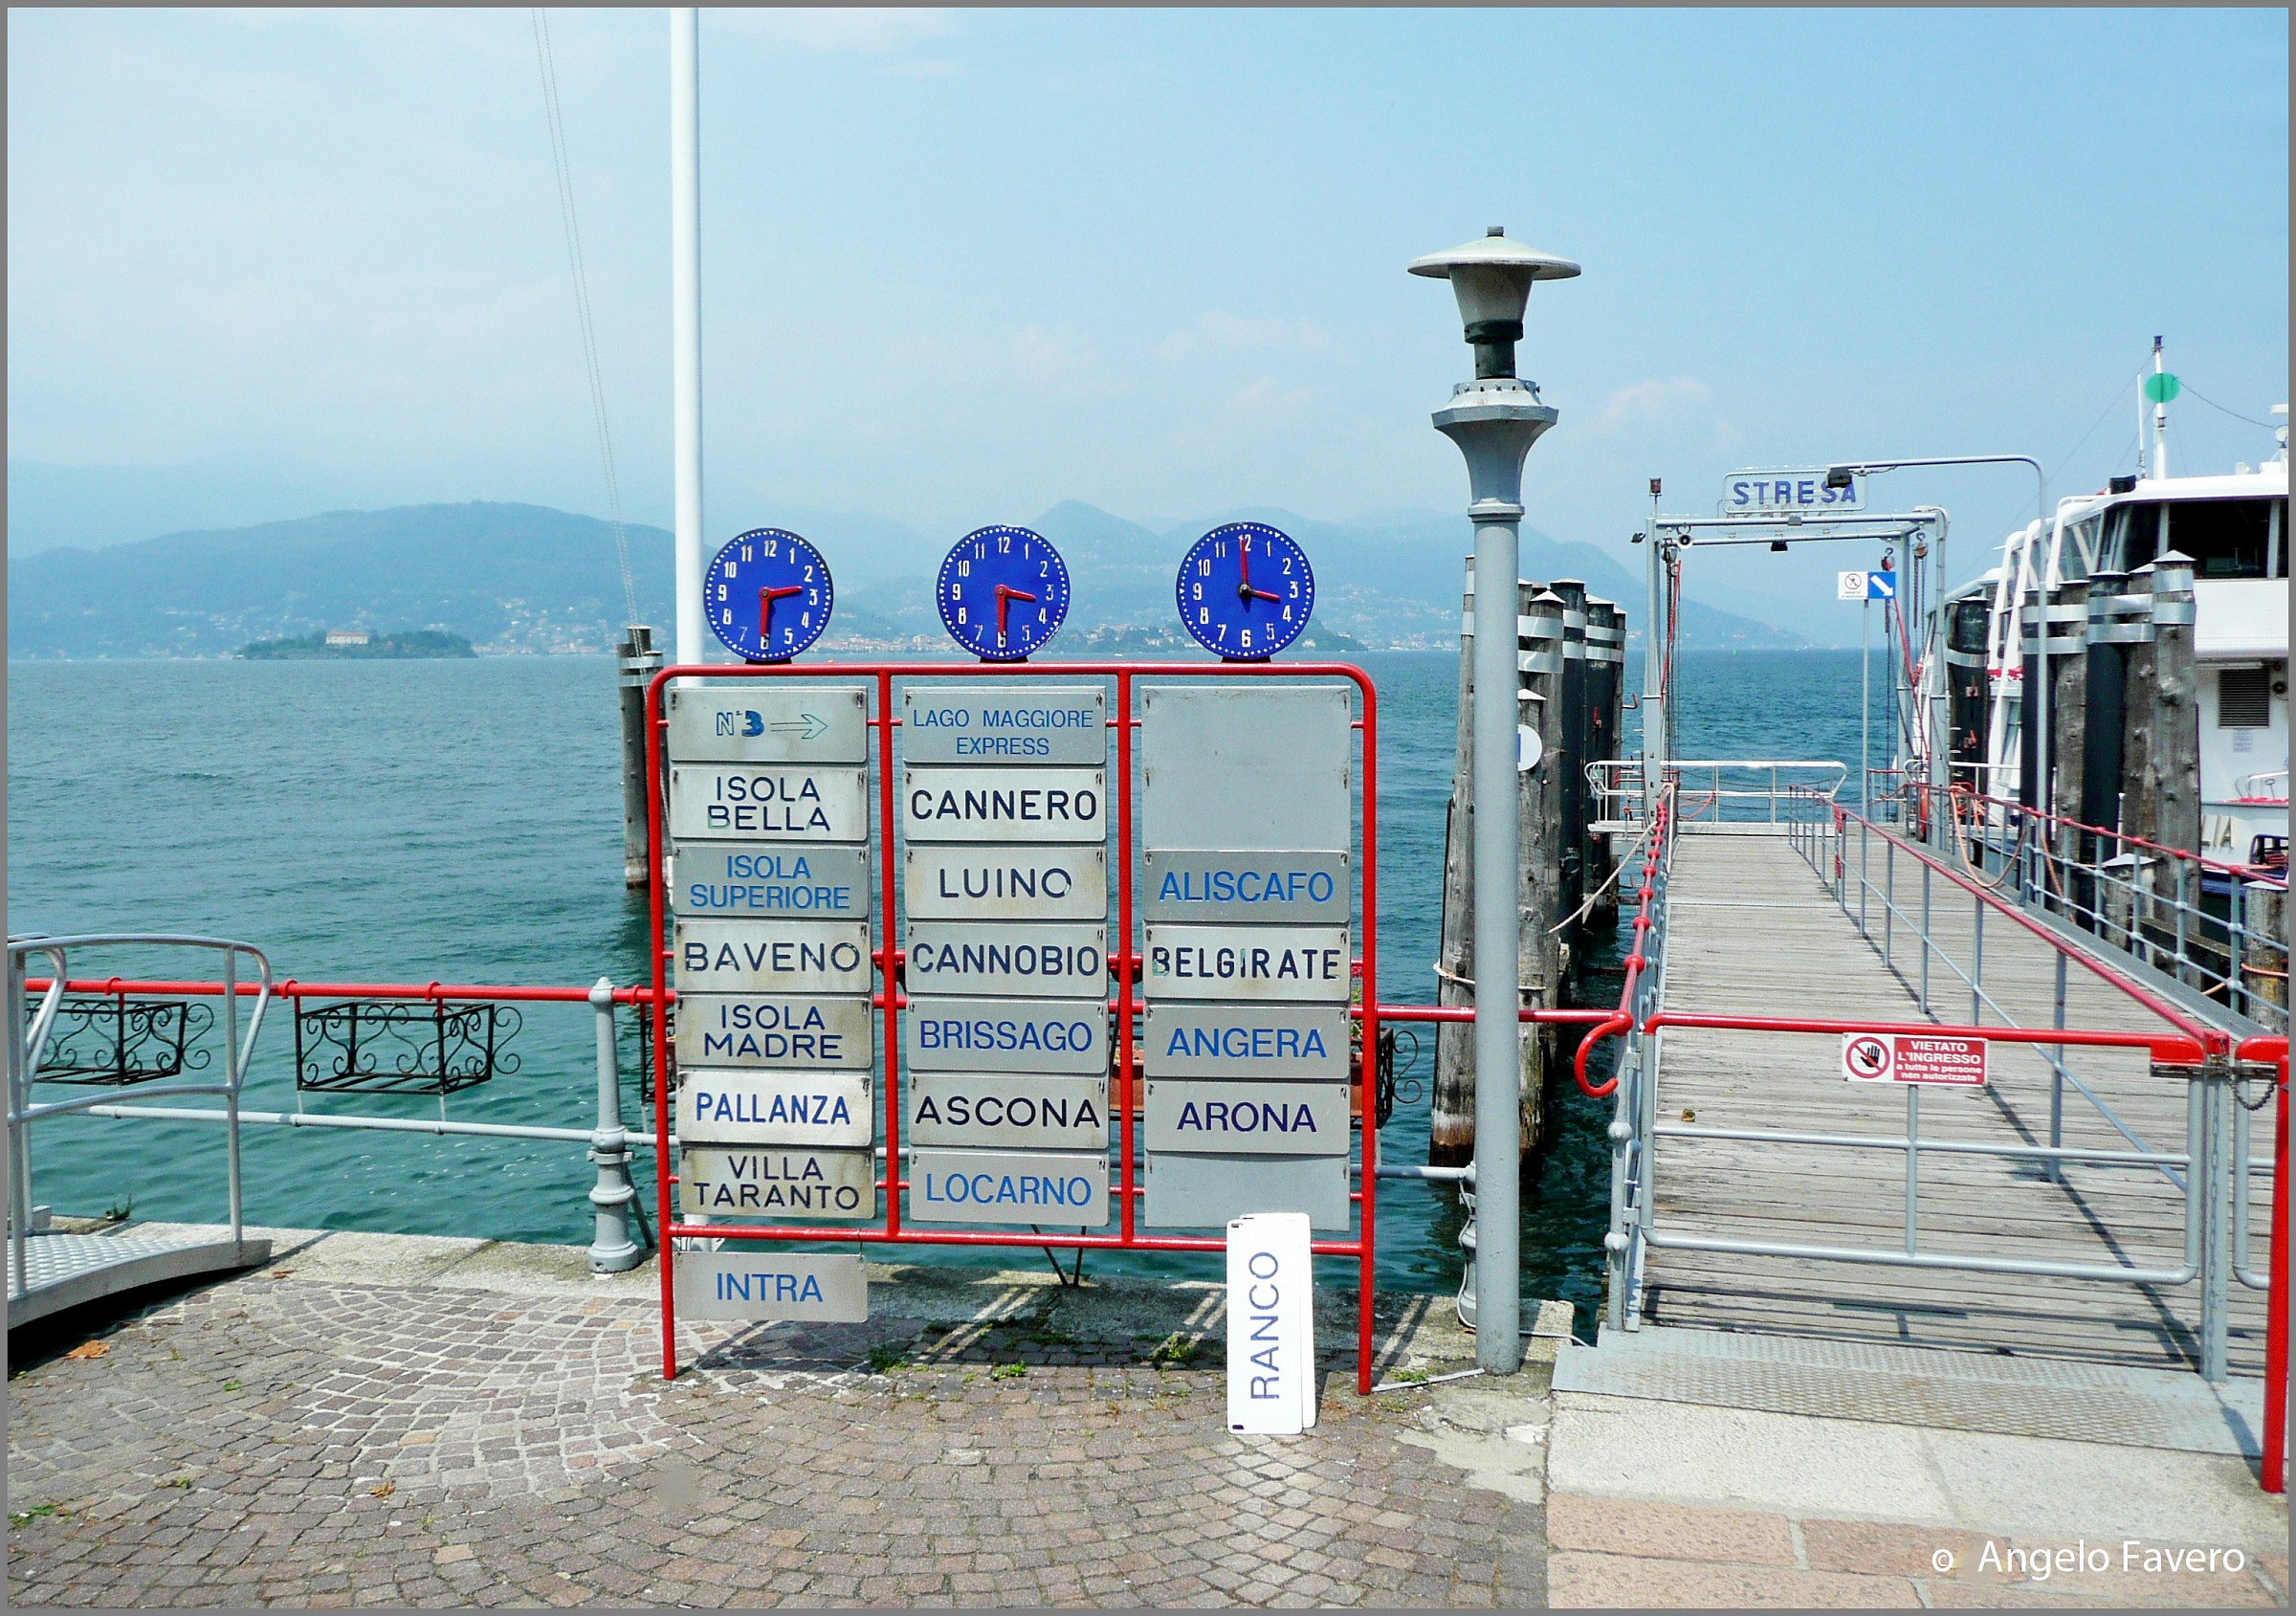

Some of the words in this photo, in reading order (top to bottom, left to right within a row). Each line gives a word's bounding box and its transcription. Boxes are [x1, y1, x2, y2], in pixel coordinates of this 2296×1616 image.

[1733, 480, 1856, 505] STRESA
[741, 545, 753, 562] 11
[764, 540, 777, 557] 12
[975, 542, 984, 559] 11
[998, 537, 1010, 553] 12
[1024, 542, 1029, 560] 1
[1215, 542, 1225, 558] 11
[1266, 541, 1271, 557] 1
[789, 547, 795, 564] 1
[724, 562, 737, 578] 10
[804, 565, 813, 583] 2
[958, 560, 970, 577] 10
[1040, 561, 1048, 577] 2
[1198, 559, 1210, 576] 10
[1283, 557, 1292, 575] 2
[718, 585, 727, 601] 9
[809, 588, 818, 606] 3
[952, 584, 960, 601] 9
[1046, 584, 1053, 601] 3
[1193, 583, 1202, 600] 9
[1290, 581, 1298, 598] 3
[722, 609, 732, 625] 8
[801, 611, 809, 629] 4
[958, 608, 966, 624] 8
[1038, 608, 1048, 624] 4
[1200, 607, 1209, 624] 8
[1283, 605, 1292, 623] 4
[739, 626, 748, 642] 7
[784, 628, 793, 645] 5
[974, 625, 983, 641] 7
[1022, 625, 1030, 641] 5
[1217, 624, 1226, 642] 7
[1242, 630, 1251, 648] 6
[1266, 623, 1274, 640] 5
[913, 709, 970, 727] LAGO
[982, 710, 1093, 728] MAGGIORE
[957, 737, 1049, 756] EXPRESS
[717, 776, 821, 802] ISOLA
[911, 789, 1097, 821] CANNERO
[707, 805, 830, 831] BELLA
[727, 855, 811, 879] ISOLA
[939, 868, 1072, 898] LUINO
[1159, 871, 1334, 903] ALISCAFO
[690, 884, 850, 909] SUPERIORE
[684, 941, 861, 973] BAVENO
[912, 942, 1099, 976] CANNOBIO
[1152, 946, 1340, 981] BELGIRATE
[721, 1004, 826, 1030] ISOLA
[920, 1020, 1093, 1052] BRISSAGO
[1166, 1028, 1328, 1058] ANGERA
[704, 1032, 843, 1059] MADRE
[1910, 1040, 1968, 1052] VIETATO
[1897, 1052, 1981, 1065] L'INGRESSO
[1922, 1073, 1977, 1081] autorizzate
[696, 1092, 850, 1125] PALLANZA
[915, 1096, 1100, 1129] ASCONA
[1177, 1101, 1317, 1133] ARONA
[728, 1155, 824, 1181] VILLA
[693, 1183, 860, 1210] TARANTO
[926, 1173, 1092, 1207] LOCARNO
[717, 1273, 824, 1303] INTRA
[1248, 1251, 1280, 1400] RANCO
